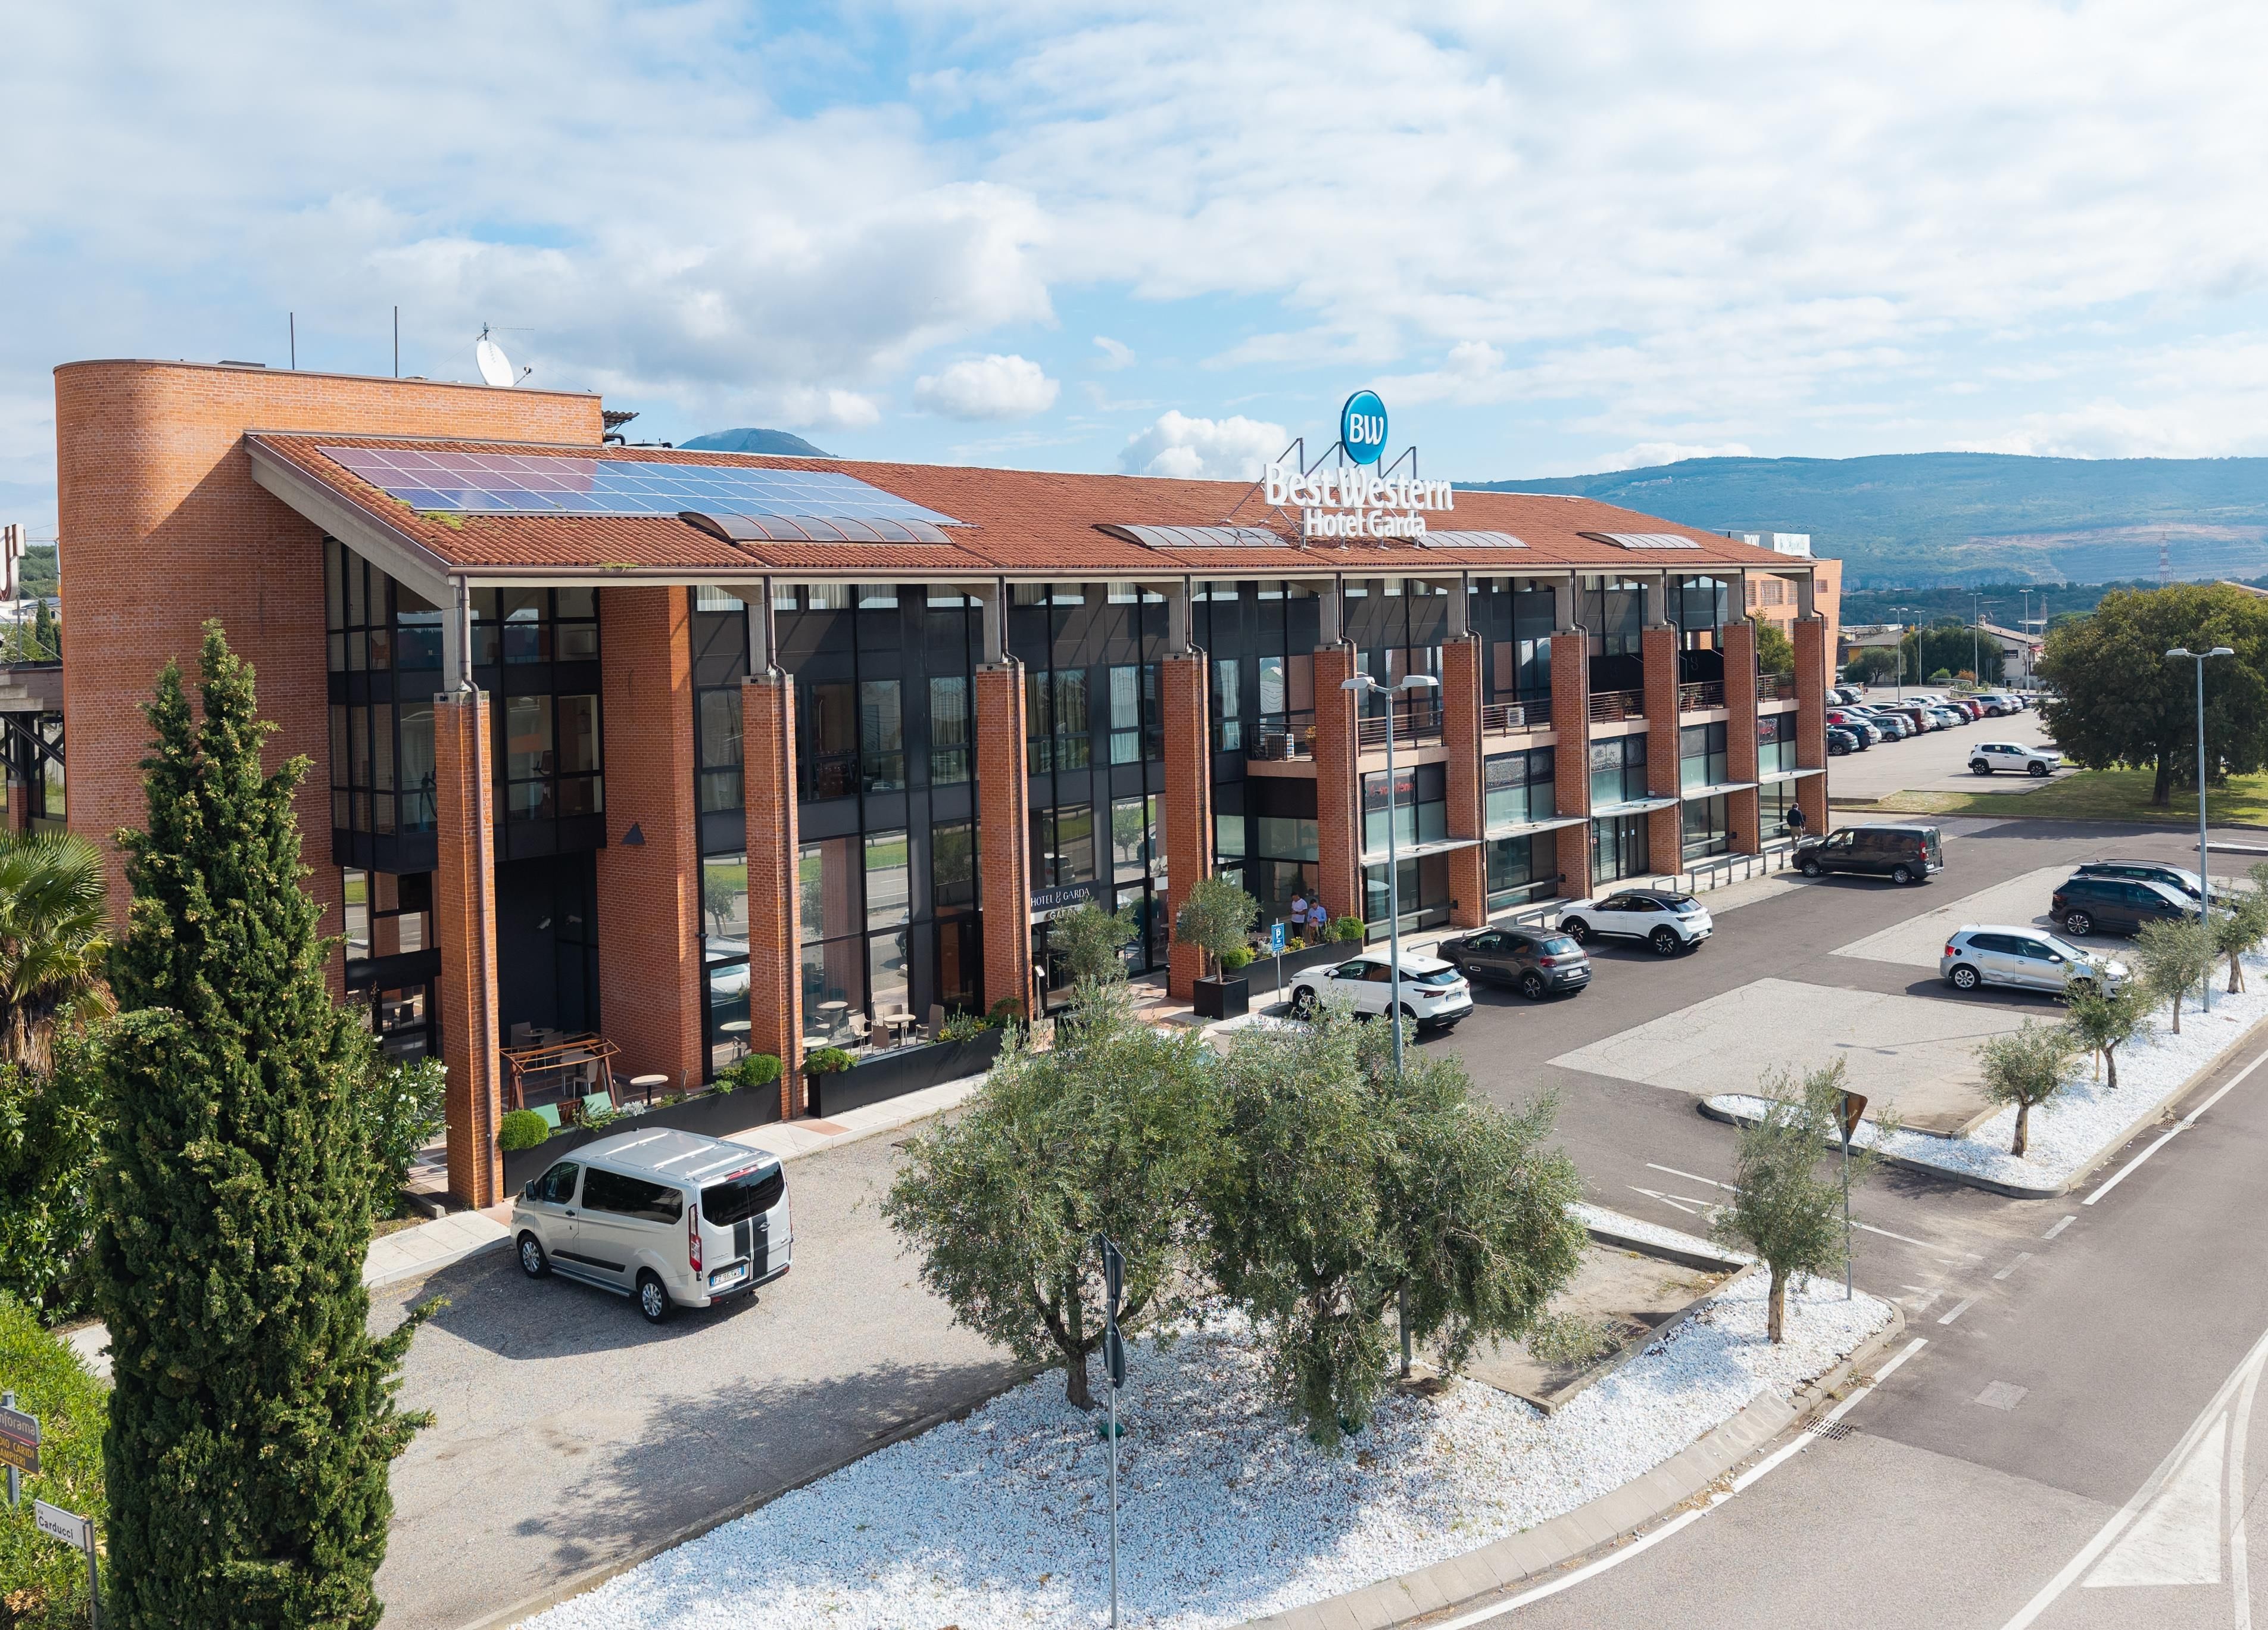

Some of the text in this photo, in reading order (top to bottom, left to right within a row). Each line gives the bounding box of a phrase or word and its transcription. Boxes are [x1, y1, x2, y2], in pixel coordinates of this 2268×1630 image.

[1349, 413, 1384, 445] BW
[1264, 463, 1454, 511] Best Western
[1304, 508, 1427, 537] Hotel Garda
[1031, 888, 1090, 907] HOTEL GARDA
[13, 1442, 34, 1459] CARIDI
[39, 1516, 73, 1539] Carducci
